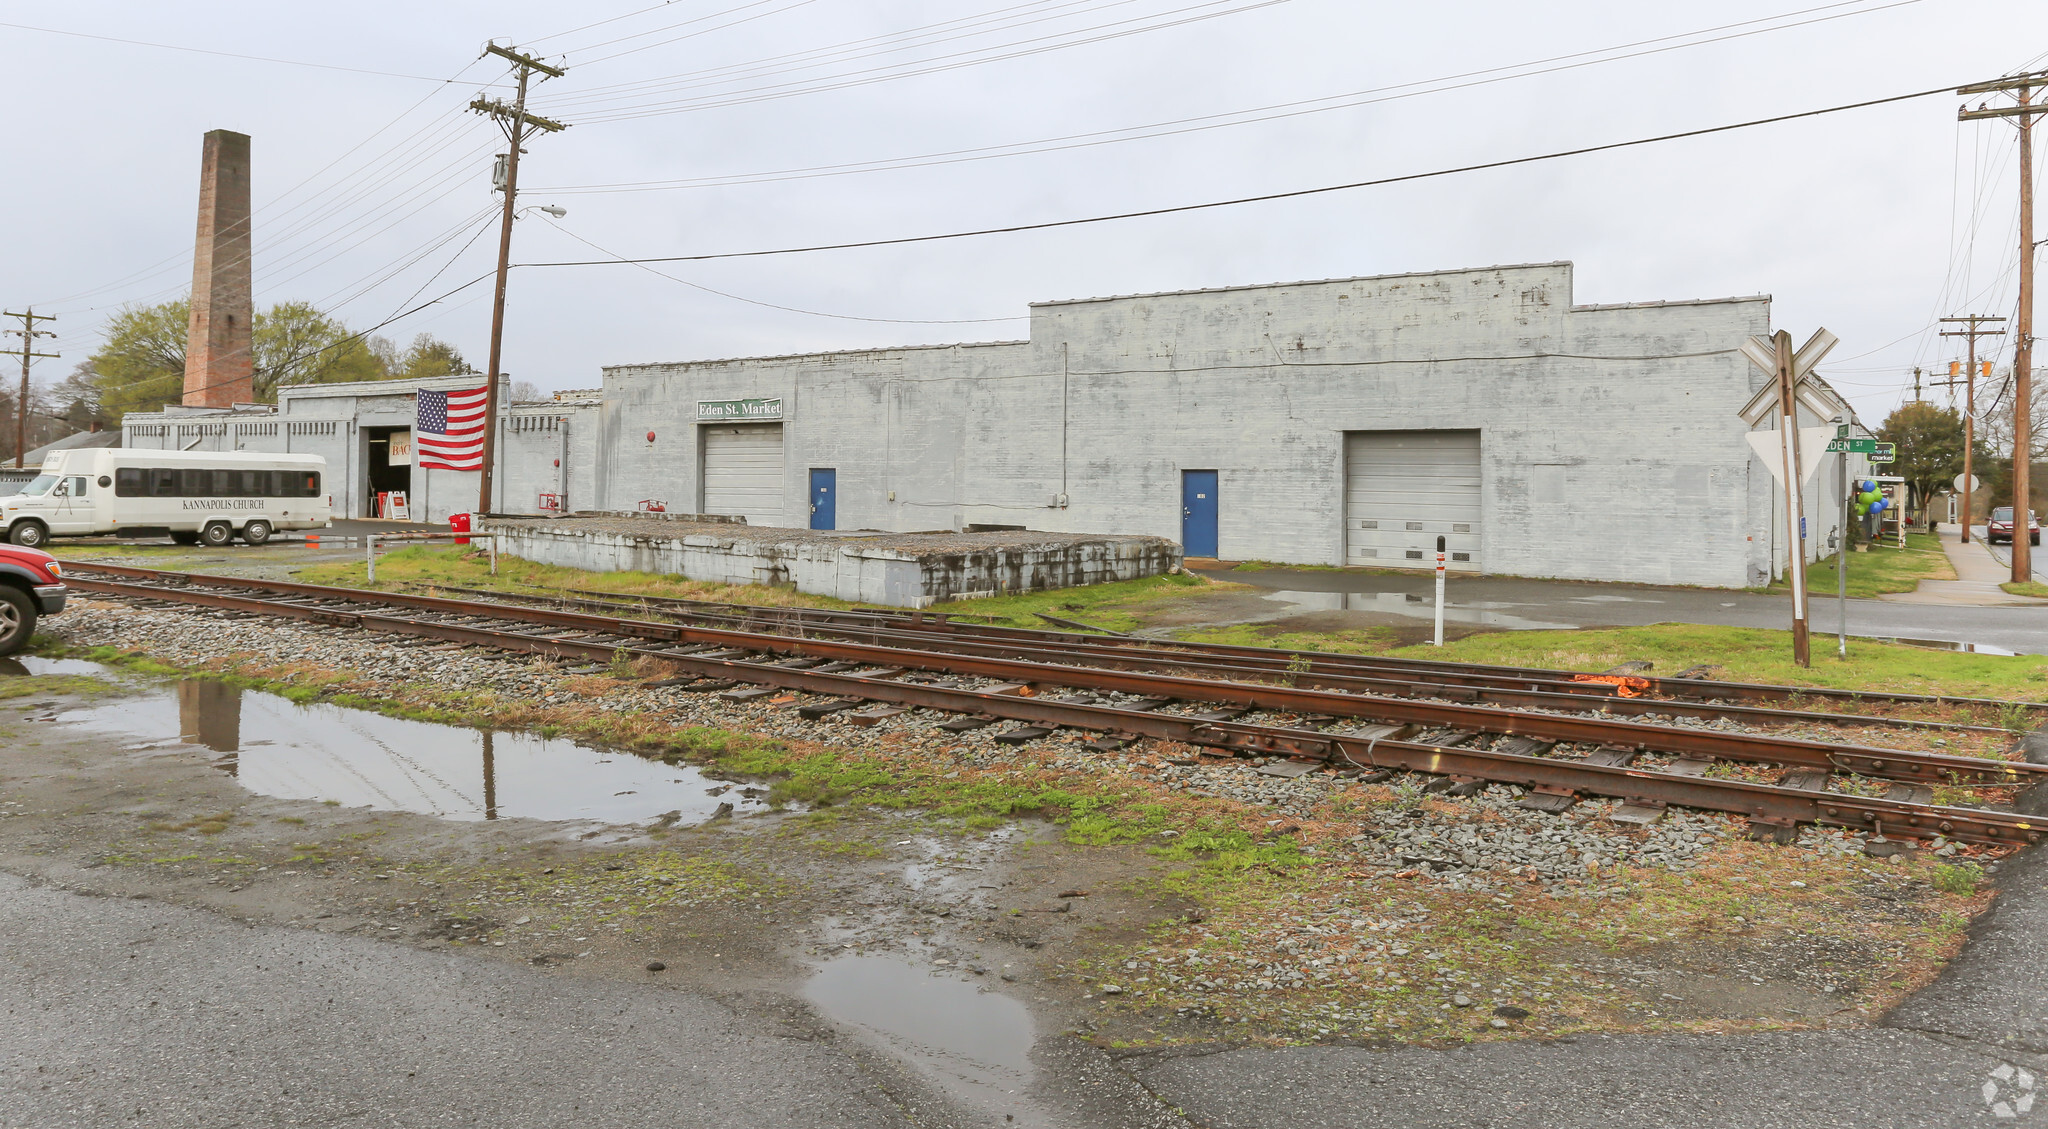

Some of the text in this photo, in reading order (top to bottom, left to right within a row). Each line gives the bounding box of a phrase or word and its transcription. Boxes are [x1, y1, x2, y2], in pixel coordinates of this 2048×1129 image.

[699, 403, 781, 416] Eden St. Market
[1827, 441, 1851, 451] DEN
[183, 499, 264, 510] KANNAPOLIS CHURCH
